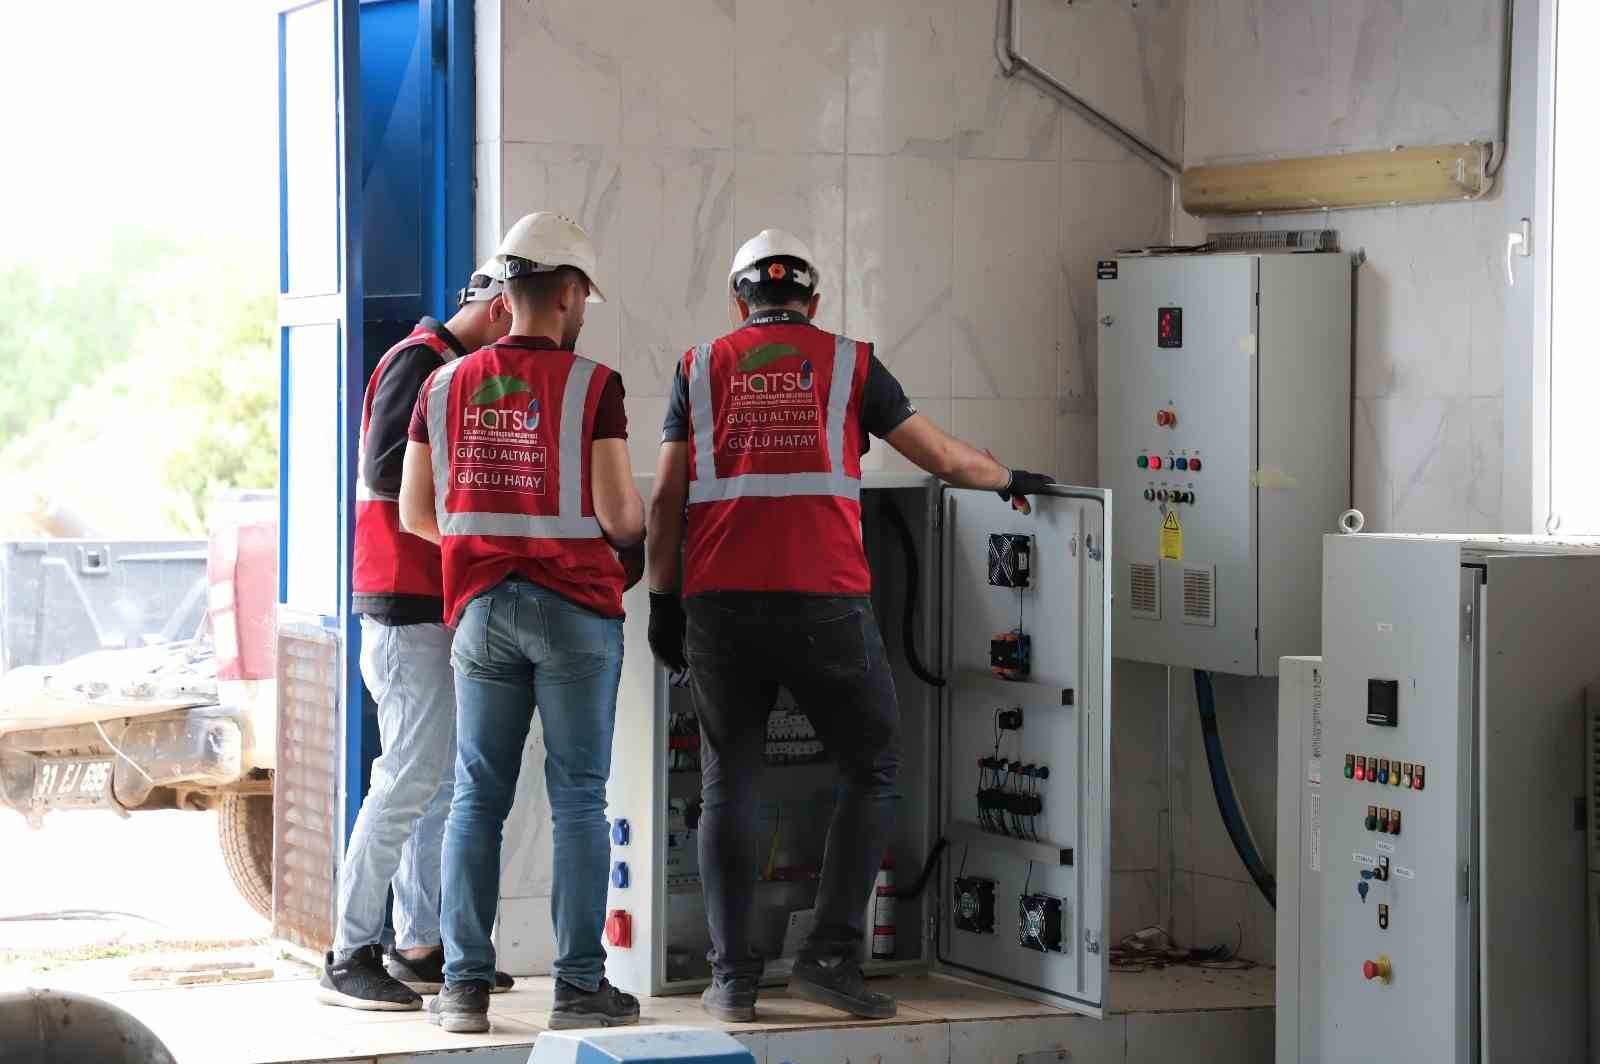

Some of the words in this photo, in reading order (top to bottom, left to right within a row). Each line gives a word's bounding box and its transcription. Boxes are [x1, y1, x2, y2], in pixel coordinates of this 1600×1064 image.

[769, 410, 818, 422] ALTYAPI
[774, 434, 817, 447] HATAY
[456, 445, 497, 461] GÜÇLÜ
[500, 449, 543, 462] ALTYAPI
[457, 468, 501, 487] GÜÇLÜ
[504, 474, 542, 489] HATAY
